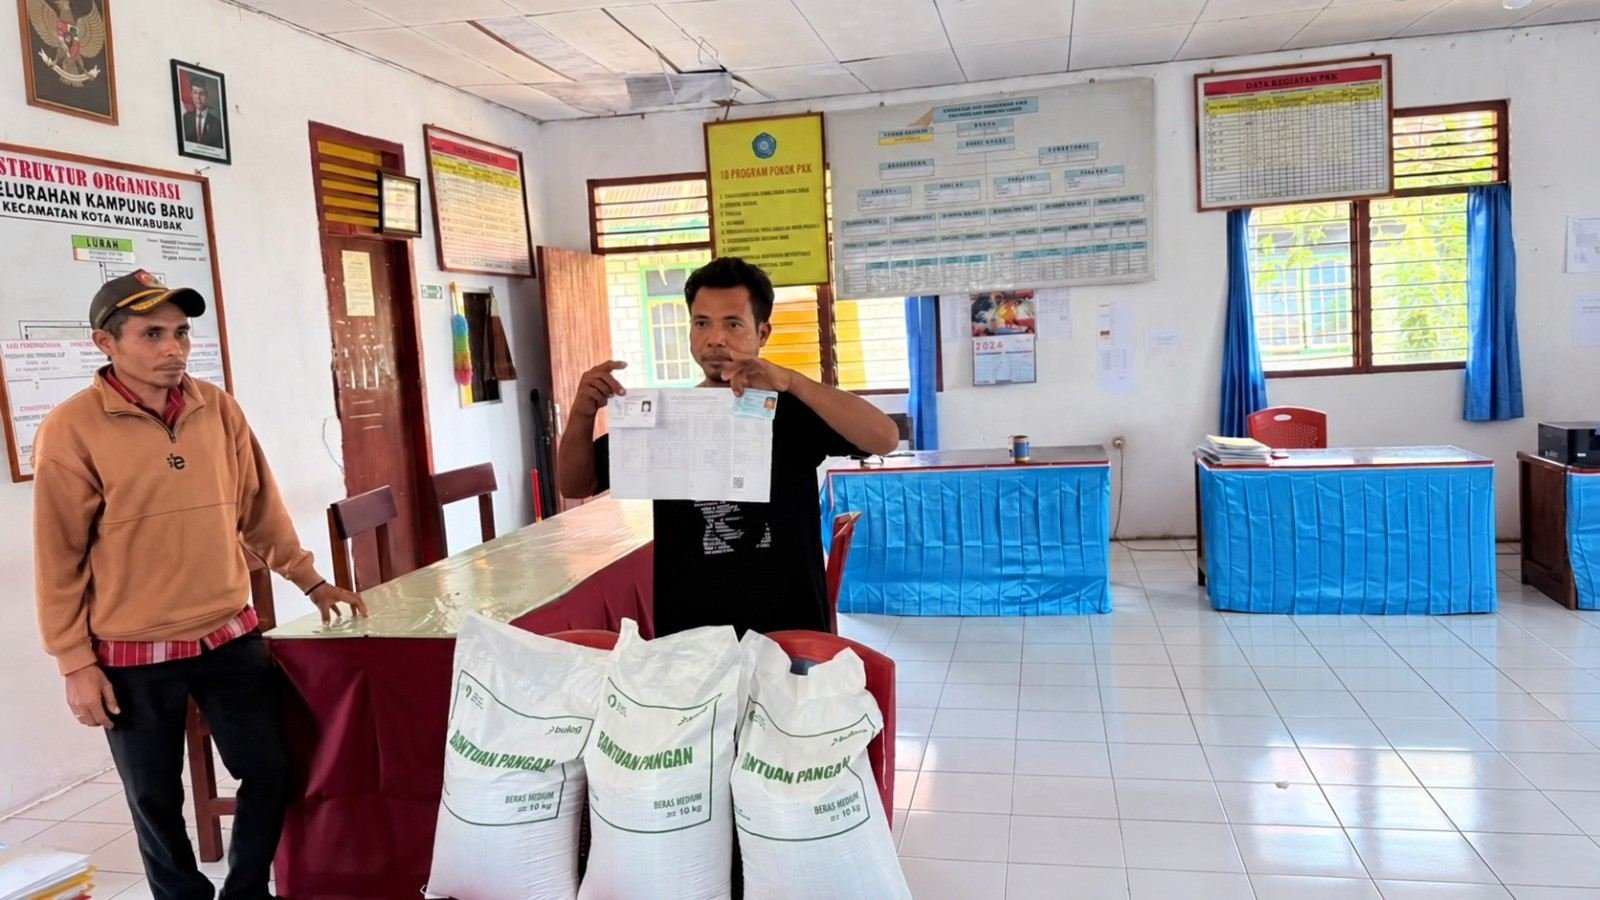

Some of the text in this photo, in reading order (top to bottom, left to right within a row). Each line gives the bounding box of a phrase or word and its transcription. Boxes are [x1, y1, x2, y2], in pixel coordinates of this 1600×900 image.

[0, 157, 181, 200] STRUKTUR ORGANISASI
[731, 167, 768, 179] PROGRAM
[769, 165, 795, 175] POKOK
[3, 201, 183, 231] KECAMATAN KOTA WAIKABUBAK
[86, 193, 156, 215] KAMPUNG
[161, 203, 194, 220] BARU
[554, 725, 582, 734] bulog
[597, 730, 693, 770] BANTUAN PANGAN
[680, 807, 690, 815] 10
